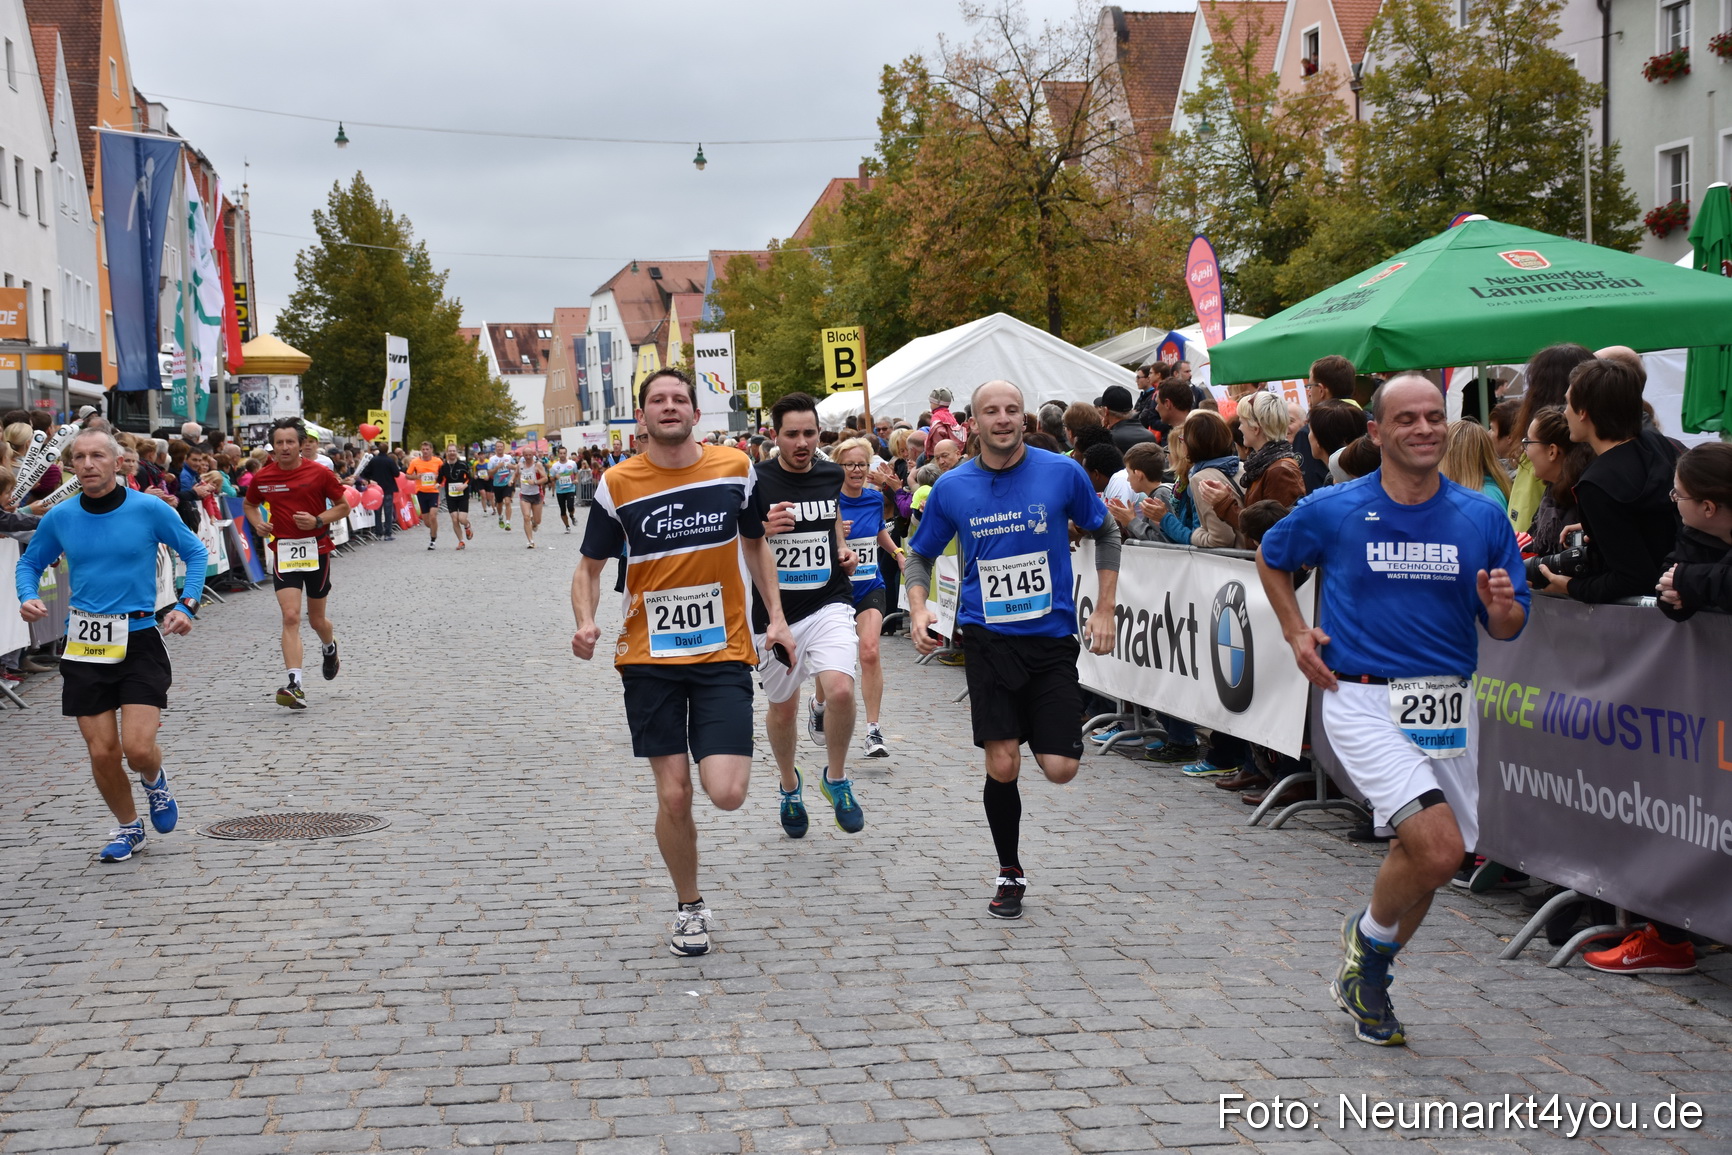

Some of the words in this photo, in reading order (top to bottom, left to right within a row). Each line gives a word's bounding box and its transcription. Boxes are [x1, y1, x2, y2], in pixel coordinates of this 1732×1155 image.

[1484, 270, 1606, 286] Neumarkter
[1468, 277, 1645, 299] Lammsbräu
[827, 329, 860, 343] Block
[834, 347, 857, 379] B
[28, 463, 47, 485] BMW
[656, 511, 727, 534] Fischer
[969, 510, 1022, 527] Kirwaläufer
[665, 524, 723, 540] AUTOMOBILE
[971, 524, 1026, 539] Pettenhofen
[290, 546, 307, 559] 20
[775, 545, 826, 568] 2219
[852, 548, 874, 564] 51
[1366, 542, 1459, 564] HUBER
[1002, 560, 1036, 571] Neumarkt
[1387, 563, 1456, 572] TECHNOLOGY
[785, 573, 818, 582] Joachim
[987, 568, 1045, 598] 2145
[646, 596, 672, 604] PARTL
[673, 592, 709, 602] Neumarkt
[1212, 584, 1248, 628] BMW
[655, 600, 715, 630] 2401
[1005, 601, 1032, 613] Benni
[79, 620, 113, 643] 281
[675, 634, 703, 646] David
[84, 646, 106, 656] Horst
[1391, 682, 1424, 691] PARTL
[1400, 692, 1462, 725] 2310
[1542, 691, 1706, 763] INDUSTRY
[1411, 733, 1455, 746] Bernhard
